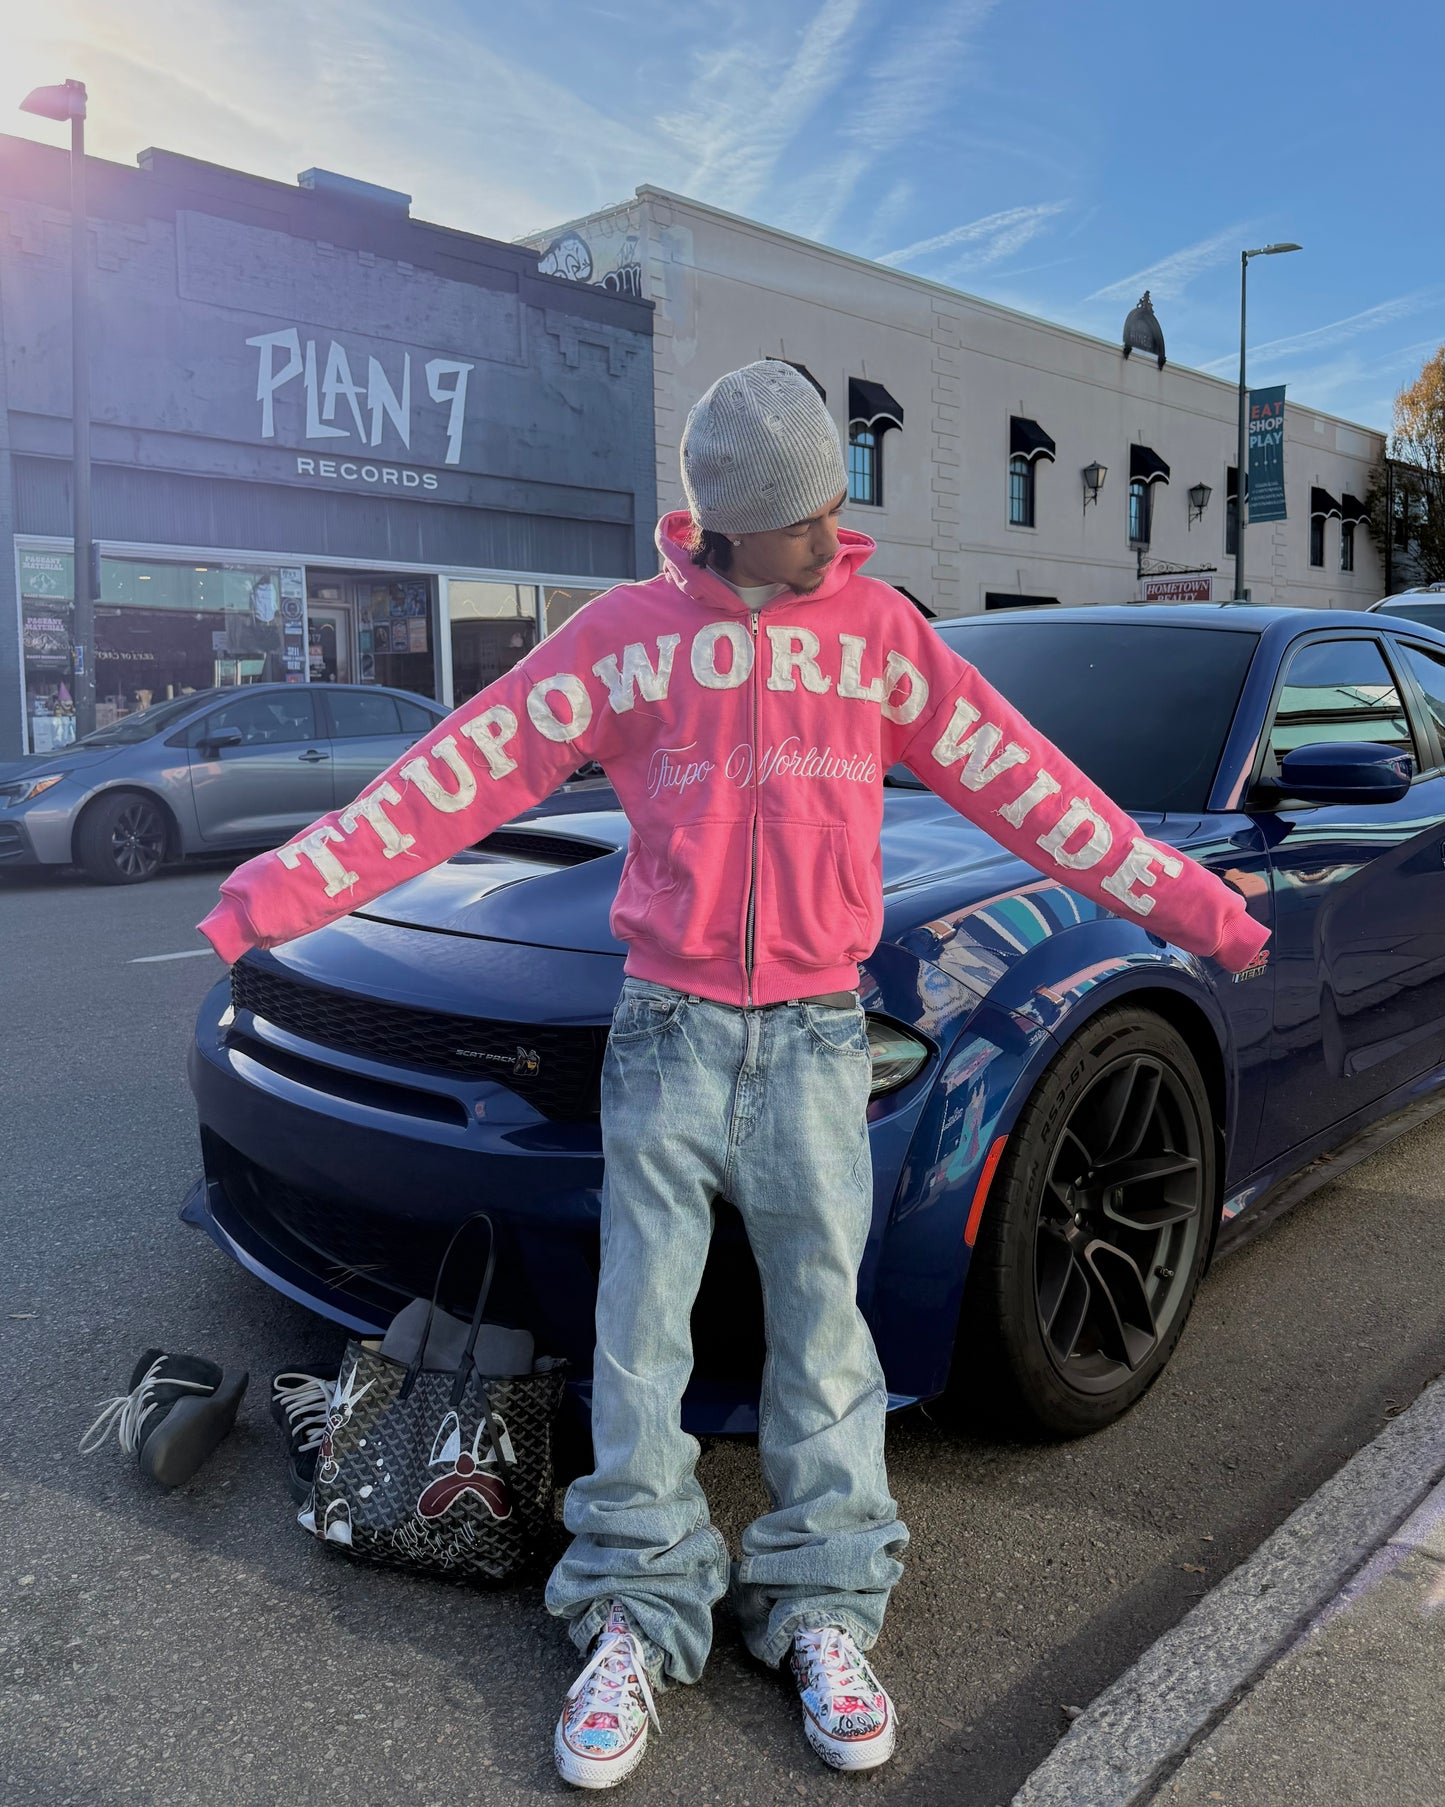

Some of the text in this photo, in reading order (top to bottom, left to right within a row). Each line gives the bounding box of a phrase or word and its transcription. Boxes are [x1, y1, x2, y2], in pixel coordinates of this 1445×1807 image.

[245, 327, 475, 465] PLAN 9
[1251, 401, 1283, 419] EAT
[1249, 416, 1283, 433] SHOP
[1249, 431, 1283, 449] PLAY
[296, 457, 439, 490] RECORDS
[1147, 580, 1209, 595] HOMETOWN
[724, 735, 877, 789] Worldwide
[455, 1048, 517, 1064] SCAT PACK
